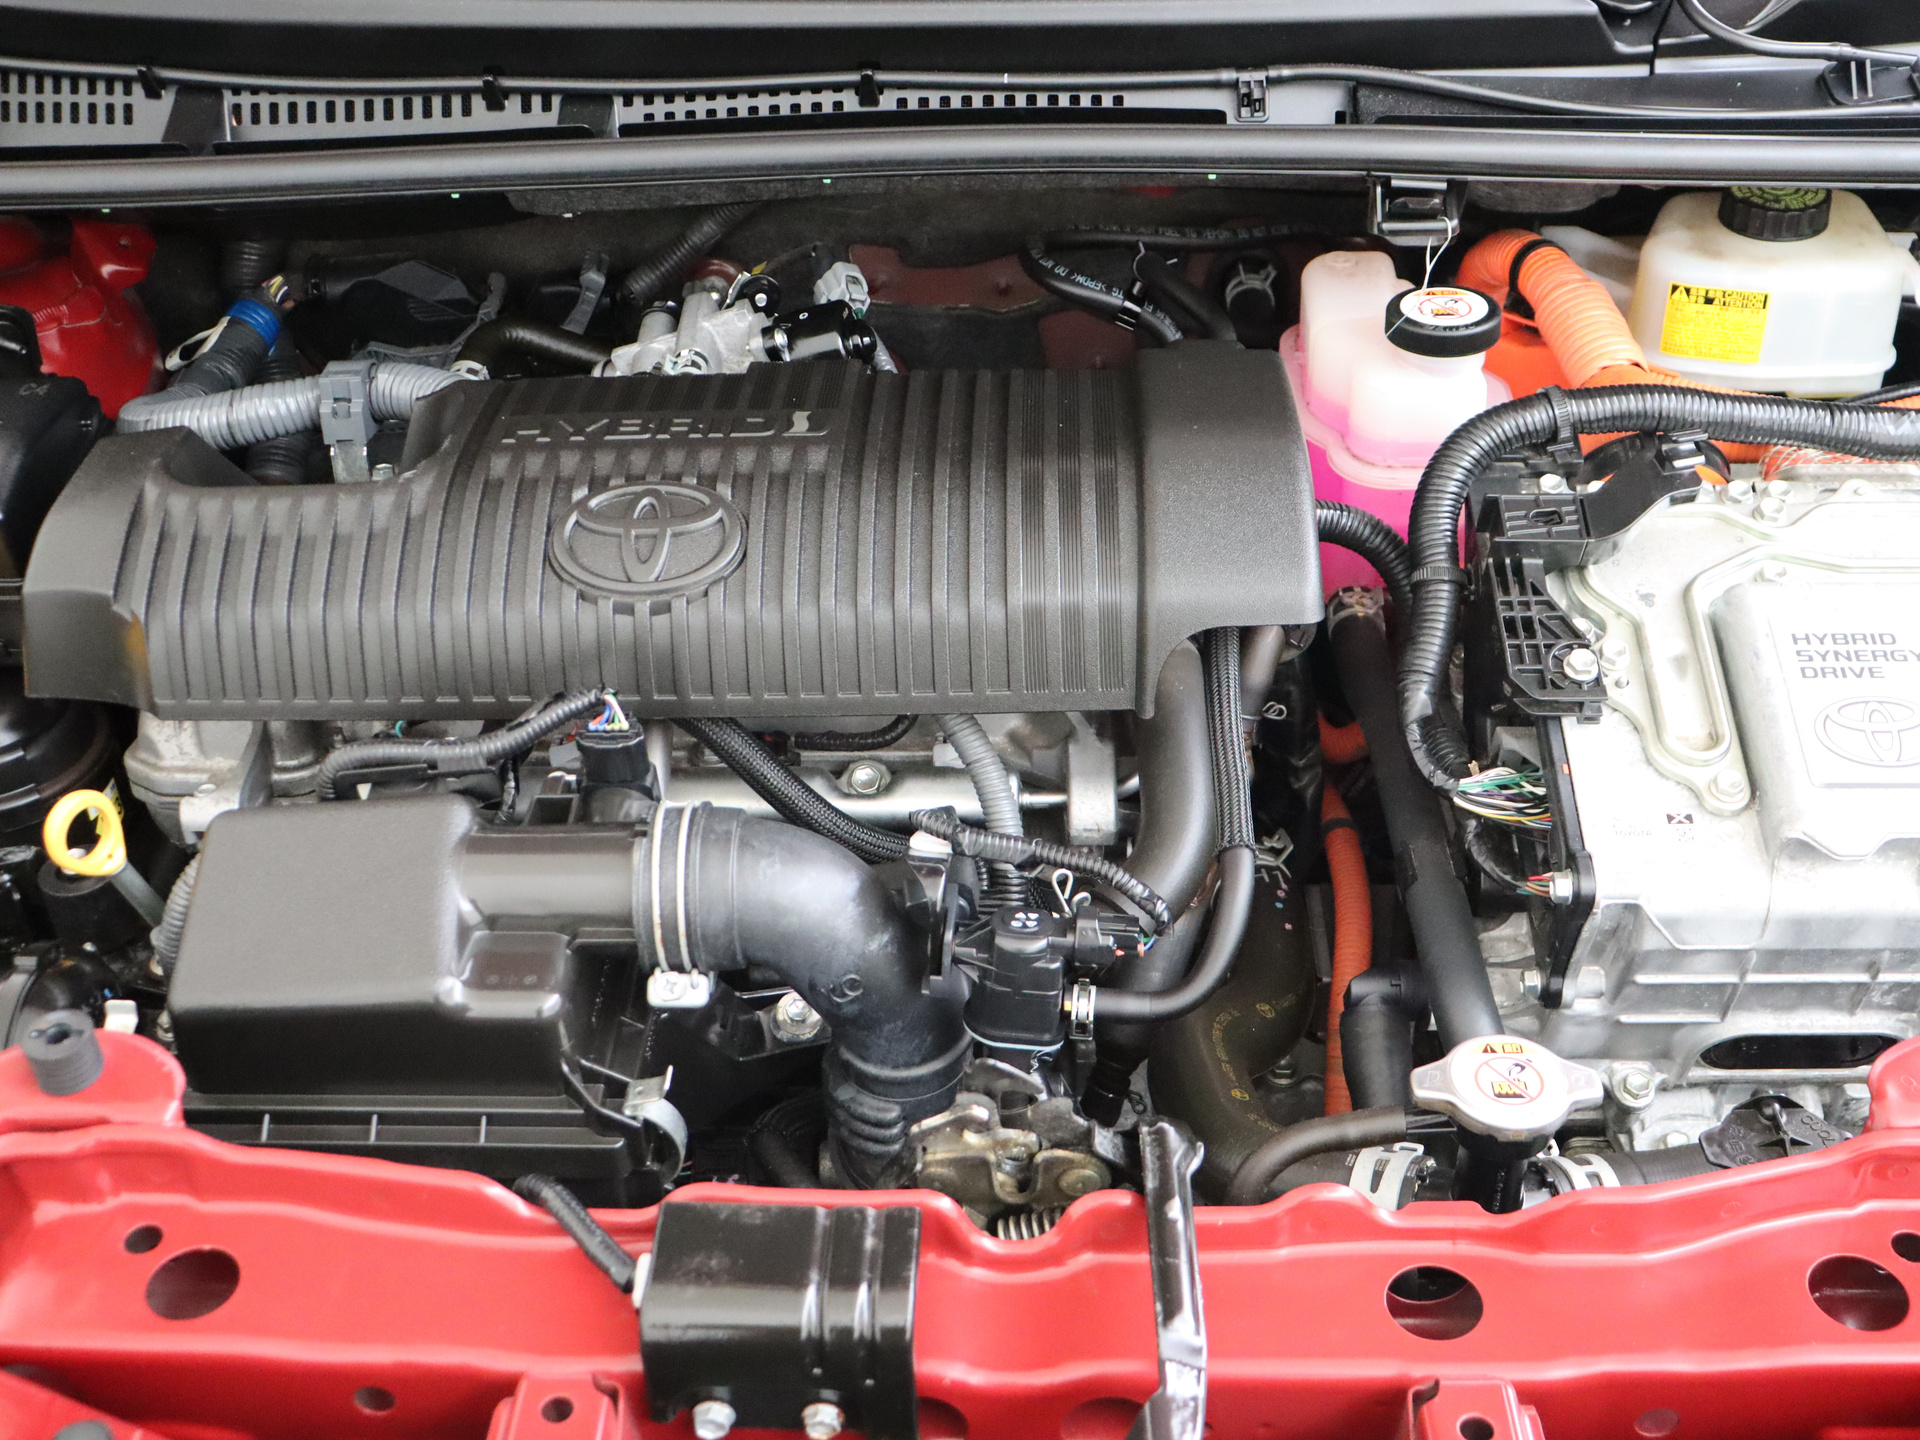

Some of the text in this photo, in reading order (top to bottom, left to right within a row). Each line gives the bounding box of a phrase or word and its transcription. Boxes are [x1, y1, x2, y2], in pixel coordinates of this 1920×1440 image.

[1054, 265, 1069, 277] DO
[1111, 287, 1125, 299] TG
[1725, 290, 1765, 301] CAUTION
[1712, 297, 1763, 309] ATTENTION
[1791, 633, 1897, 646] HYBRID
[1795, 649, 1920, 662] SYNERGY
[1800, 666, 1885, 679] DRIVE
